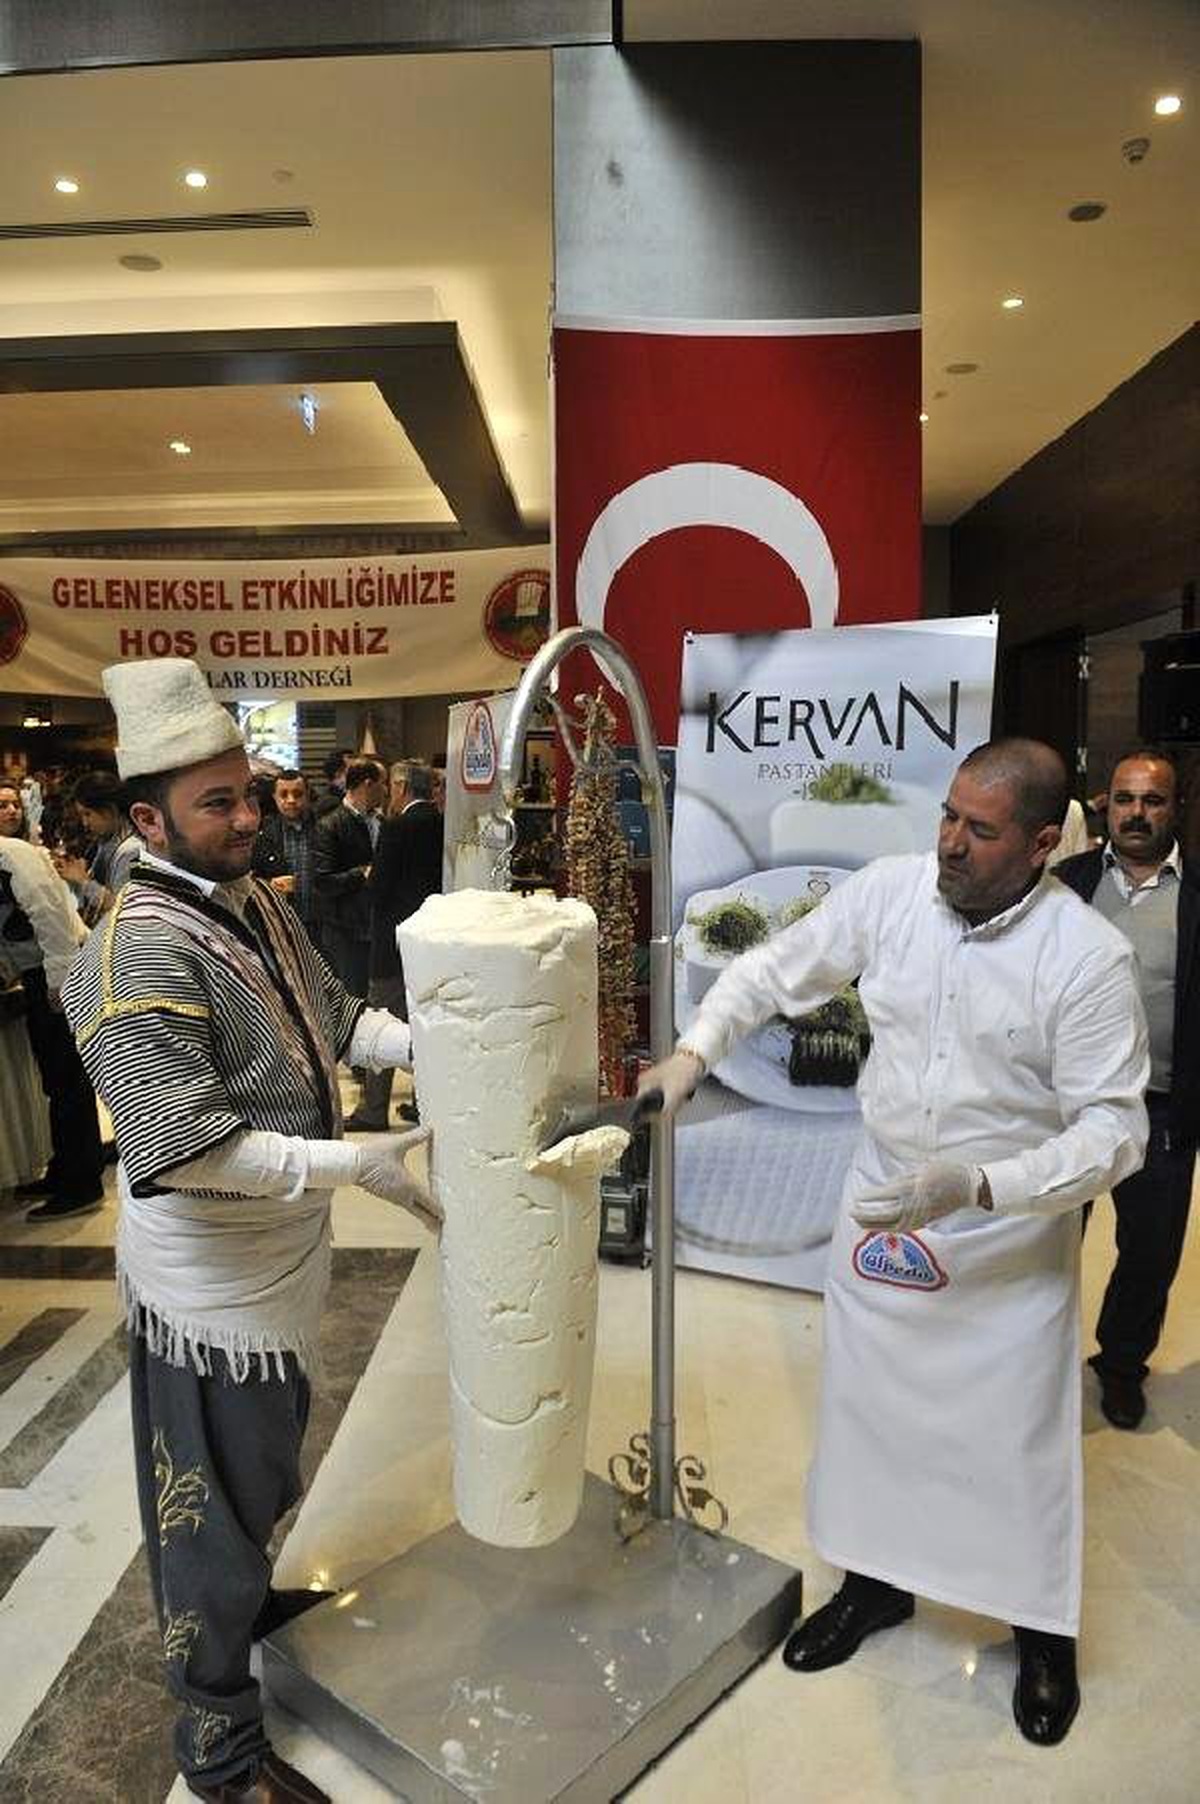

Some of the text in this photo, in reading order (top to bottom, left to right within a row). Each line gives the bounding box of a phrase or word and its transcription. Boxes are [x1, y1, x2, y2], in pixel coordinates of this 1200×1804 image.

[52, 565, 456, 611] GELENEKSEL ETKİNLİĞİMİZE
[209, 622, 389, 658] GELDİNİZ
[252, 664, 353, 688] DERNEĞİ
[706, 681, 959, 760] KERVAN
